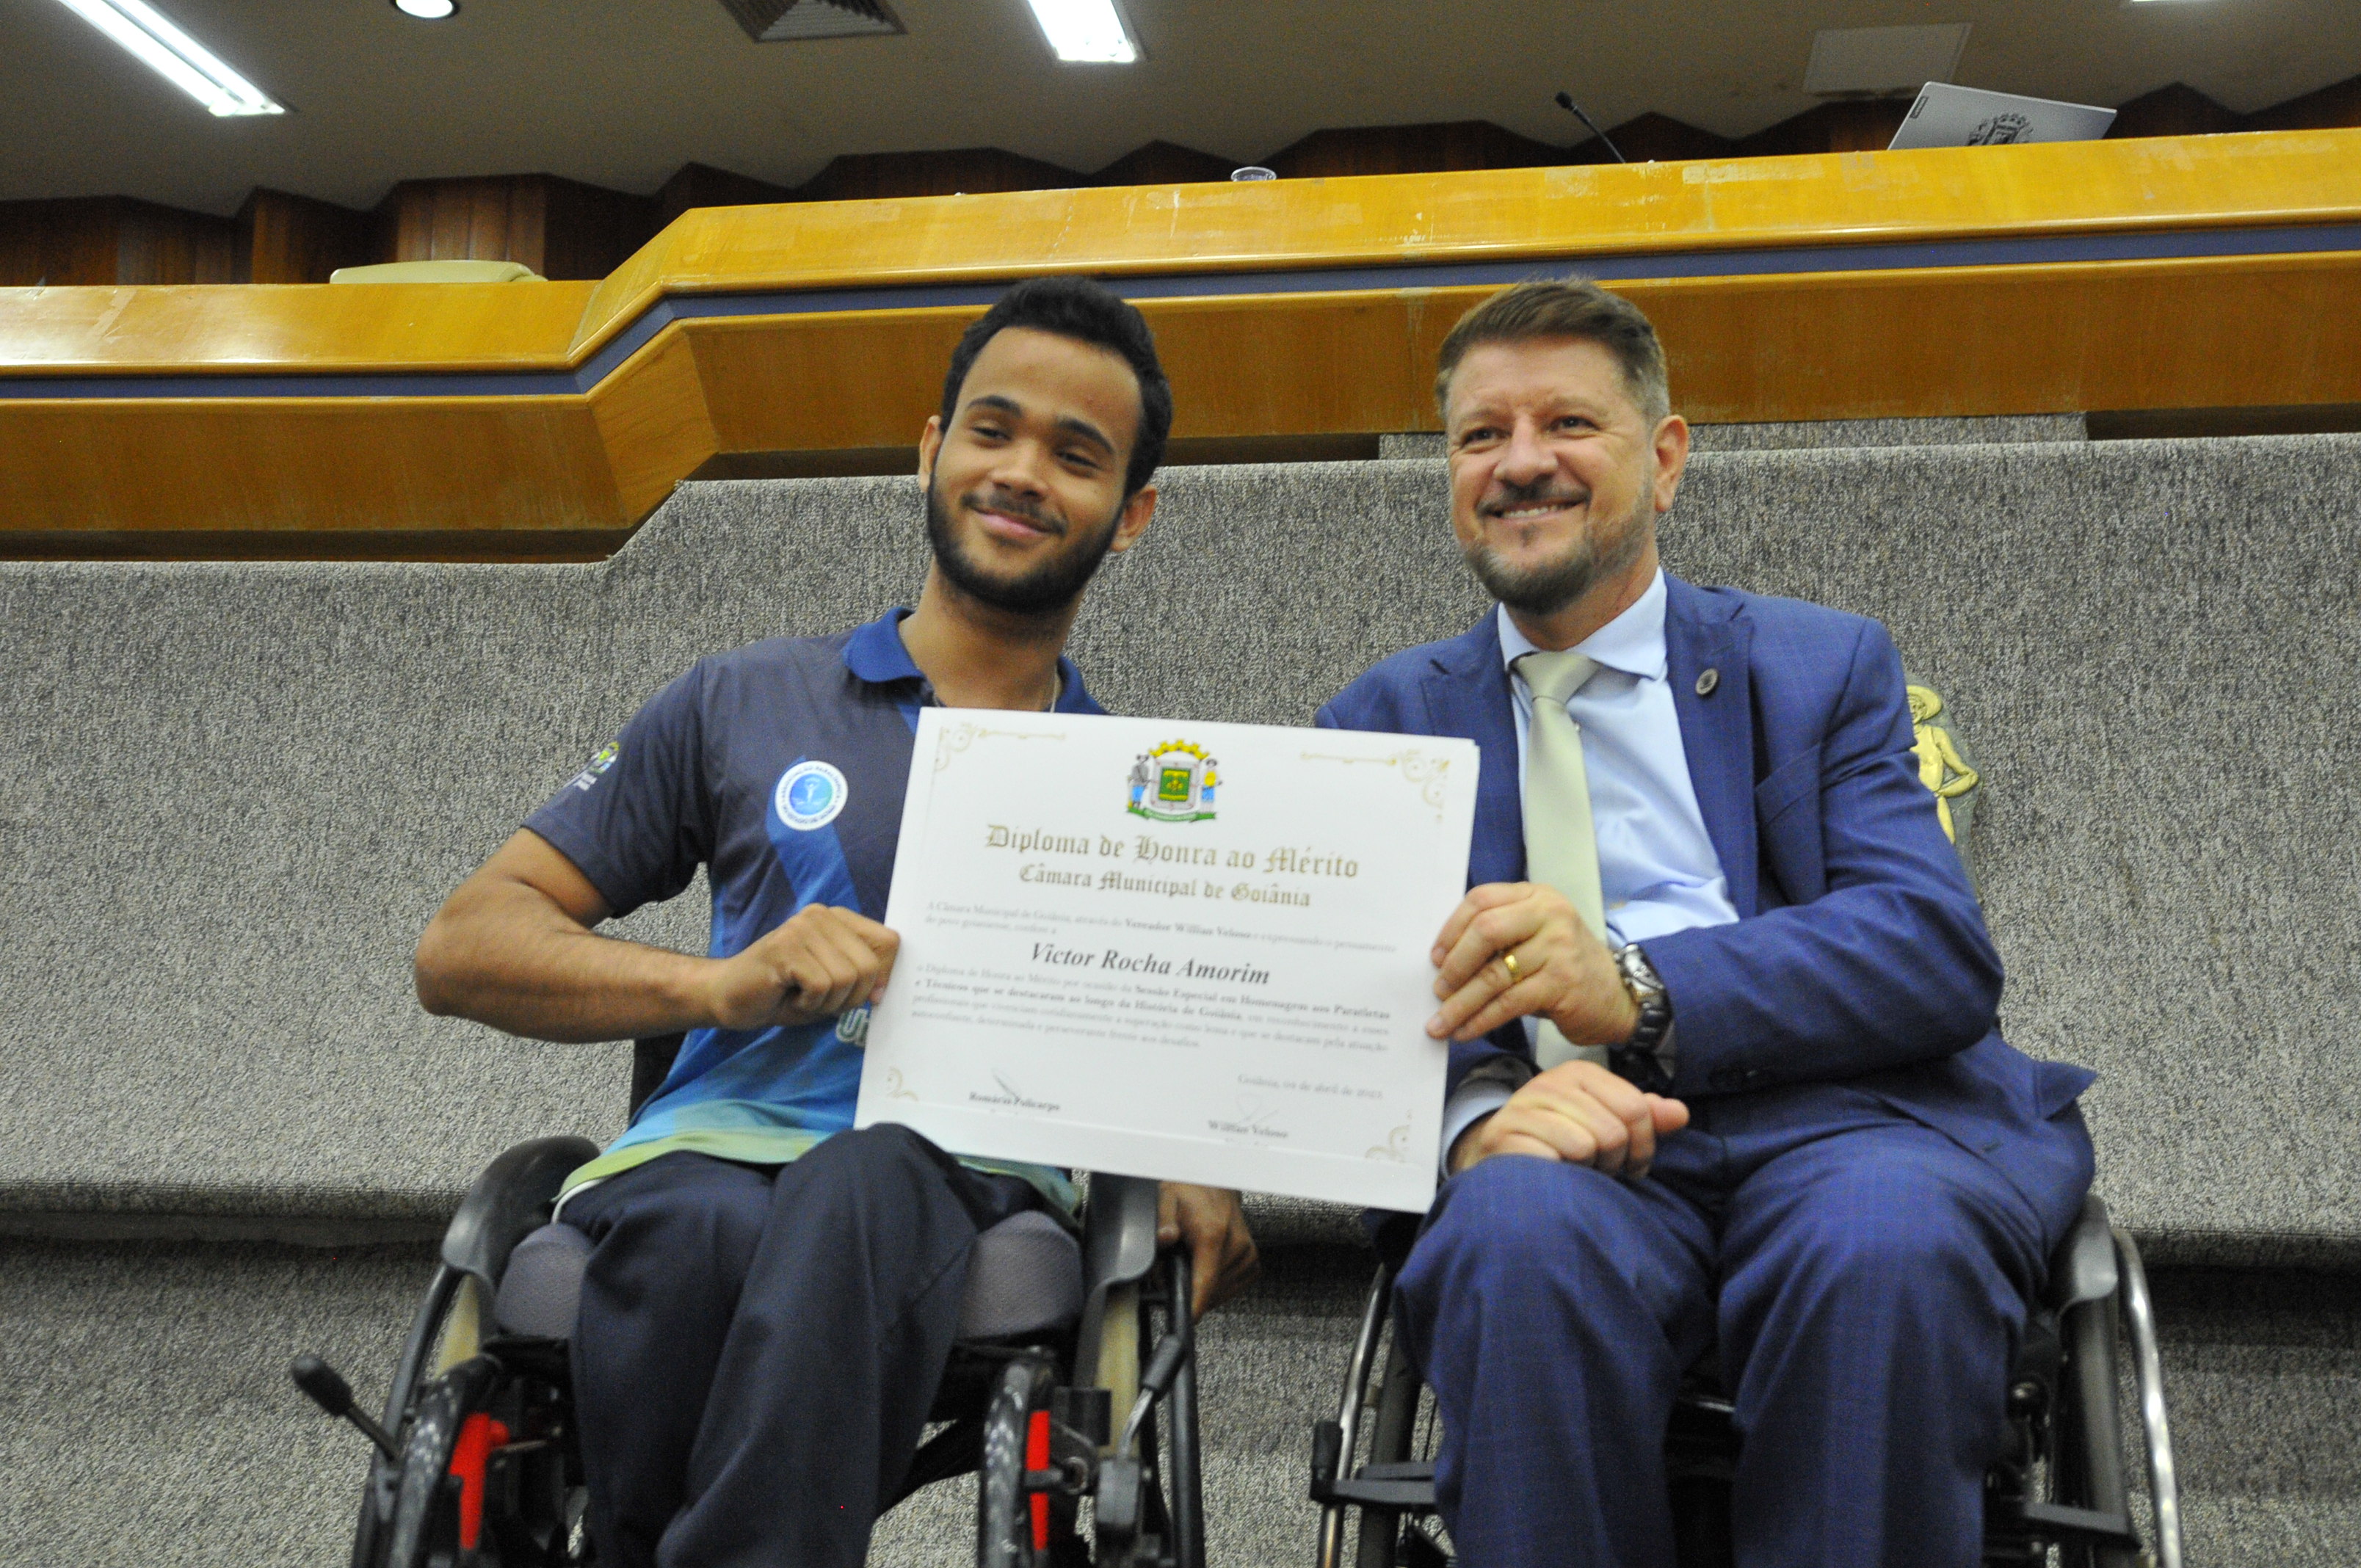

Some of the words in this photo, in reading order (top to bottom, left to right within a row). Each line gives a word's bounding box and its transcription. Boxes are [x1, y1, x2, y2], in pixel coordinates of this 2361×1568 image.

[986, 823, 1089, 854] Diploma
[1099, 834, 1125, 857] de
[1135, 835, 1217, 865] Honra
[1226, 849, 1255, 868] ao
[1262, 846, 1358, 877] Mérito
[1019, 862, 1092, 887] Câmara
[1098, 869, 1197, 897] Municipal
[1203, 881, 1224, 899] de
[1230, 882, 1310, 907] Goiânia
[1030, 942, 1095, 967] Victor
[1100, 949, 1172, 975] Rocha
[1176, 957, 1270, 984] Amorim
